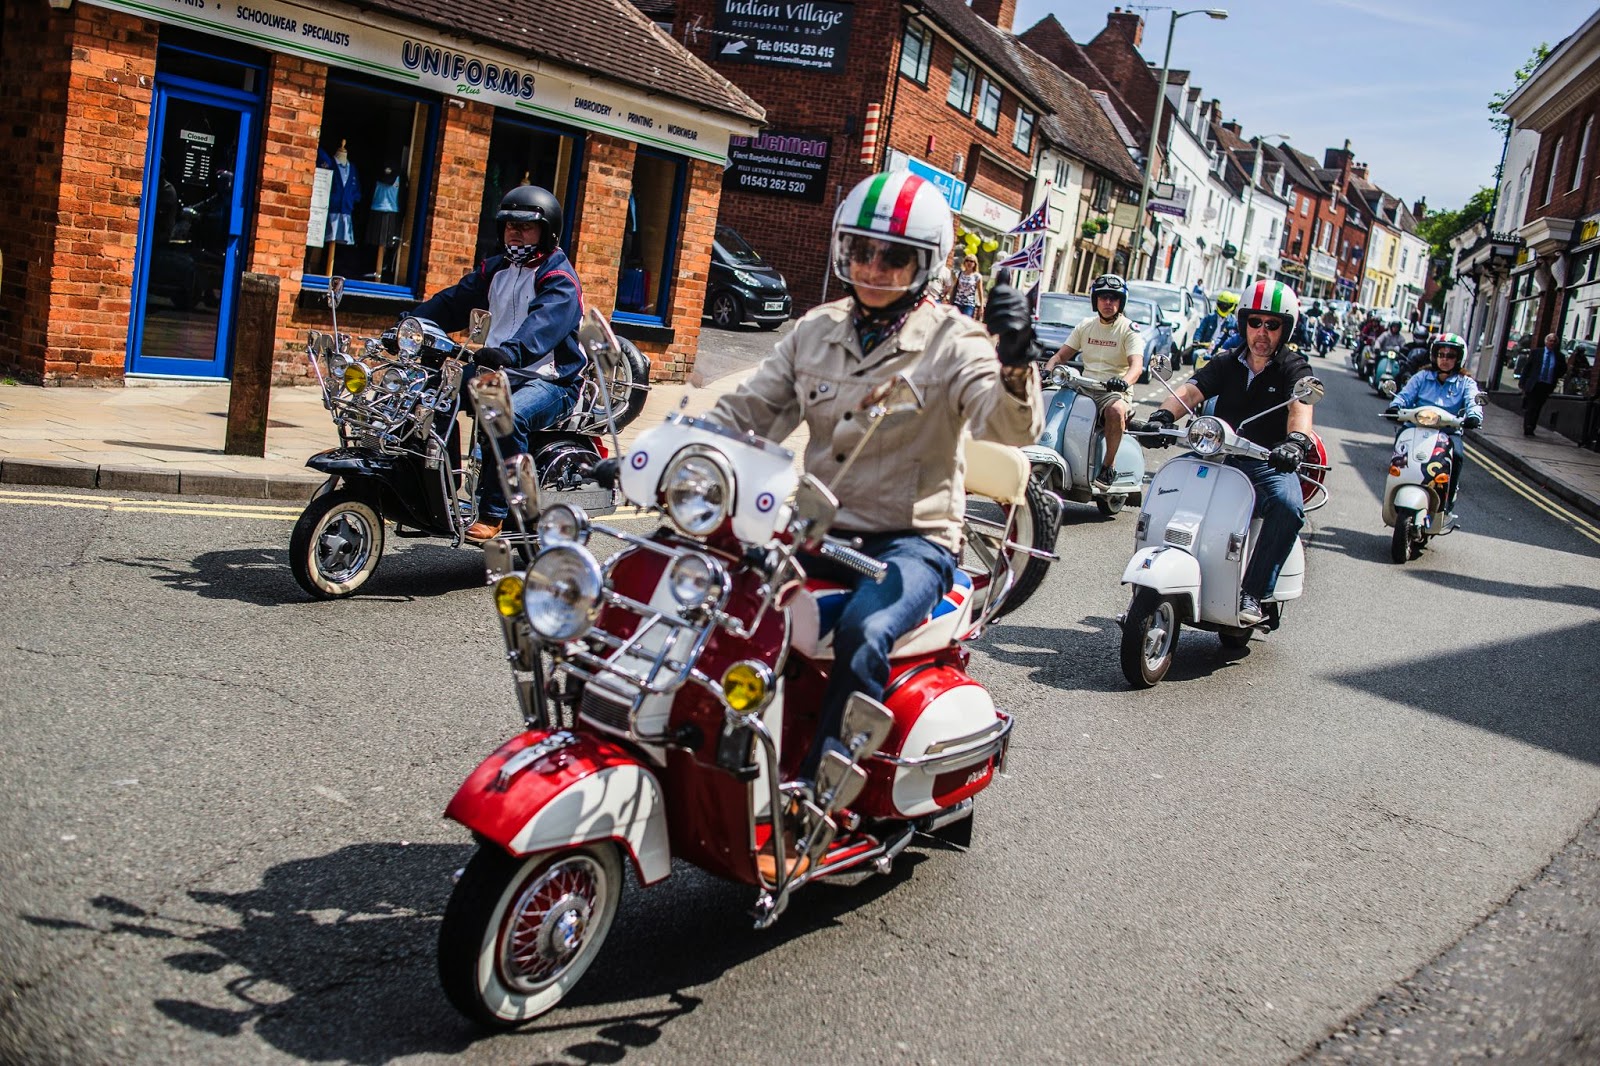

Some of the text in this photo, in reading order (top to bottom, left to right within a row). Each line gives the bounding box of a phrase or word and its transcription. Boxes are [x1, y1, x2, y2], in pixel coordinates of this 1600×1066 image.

[236, 5, 297, 33] SCHOOLWEAR
[302, 23, 350, 47] SPECIALISTS
[725, 0, 843, 31] Indian Village
[732, 20, 789, 32] RESTAURANT
[804, 27, 823, 36] BAR
[756, 40, 835, 58] Tel: 01543 253 415
[402, 40, 536, 100] UNIFORMS
[456, 84, 481, 95] Plus
[574, 97, 698, 141] EMBROIDERY PRINTING WORKWEAR
[187, 132, 208, 141] Closed
[752, 134, 827, 157] Lichfield
[740, 174, 806, 193] 01543 262 520
